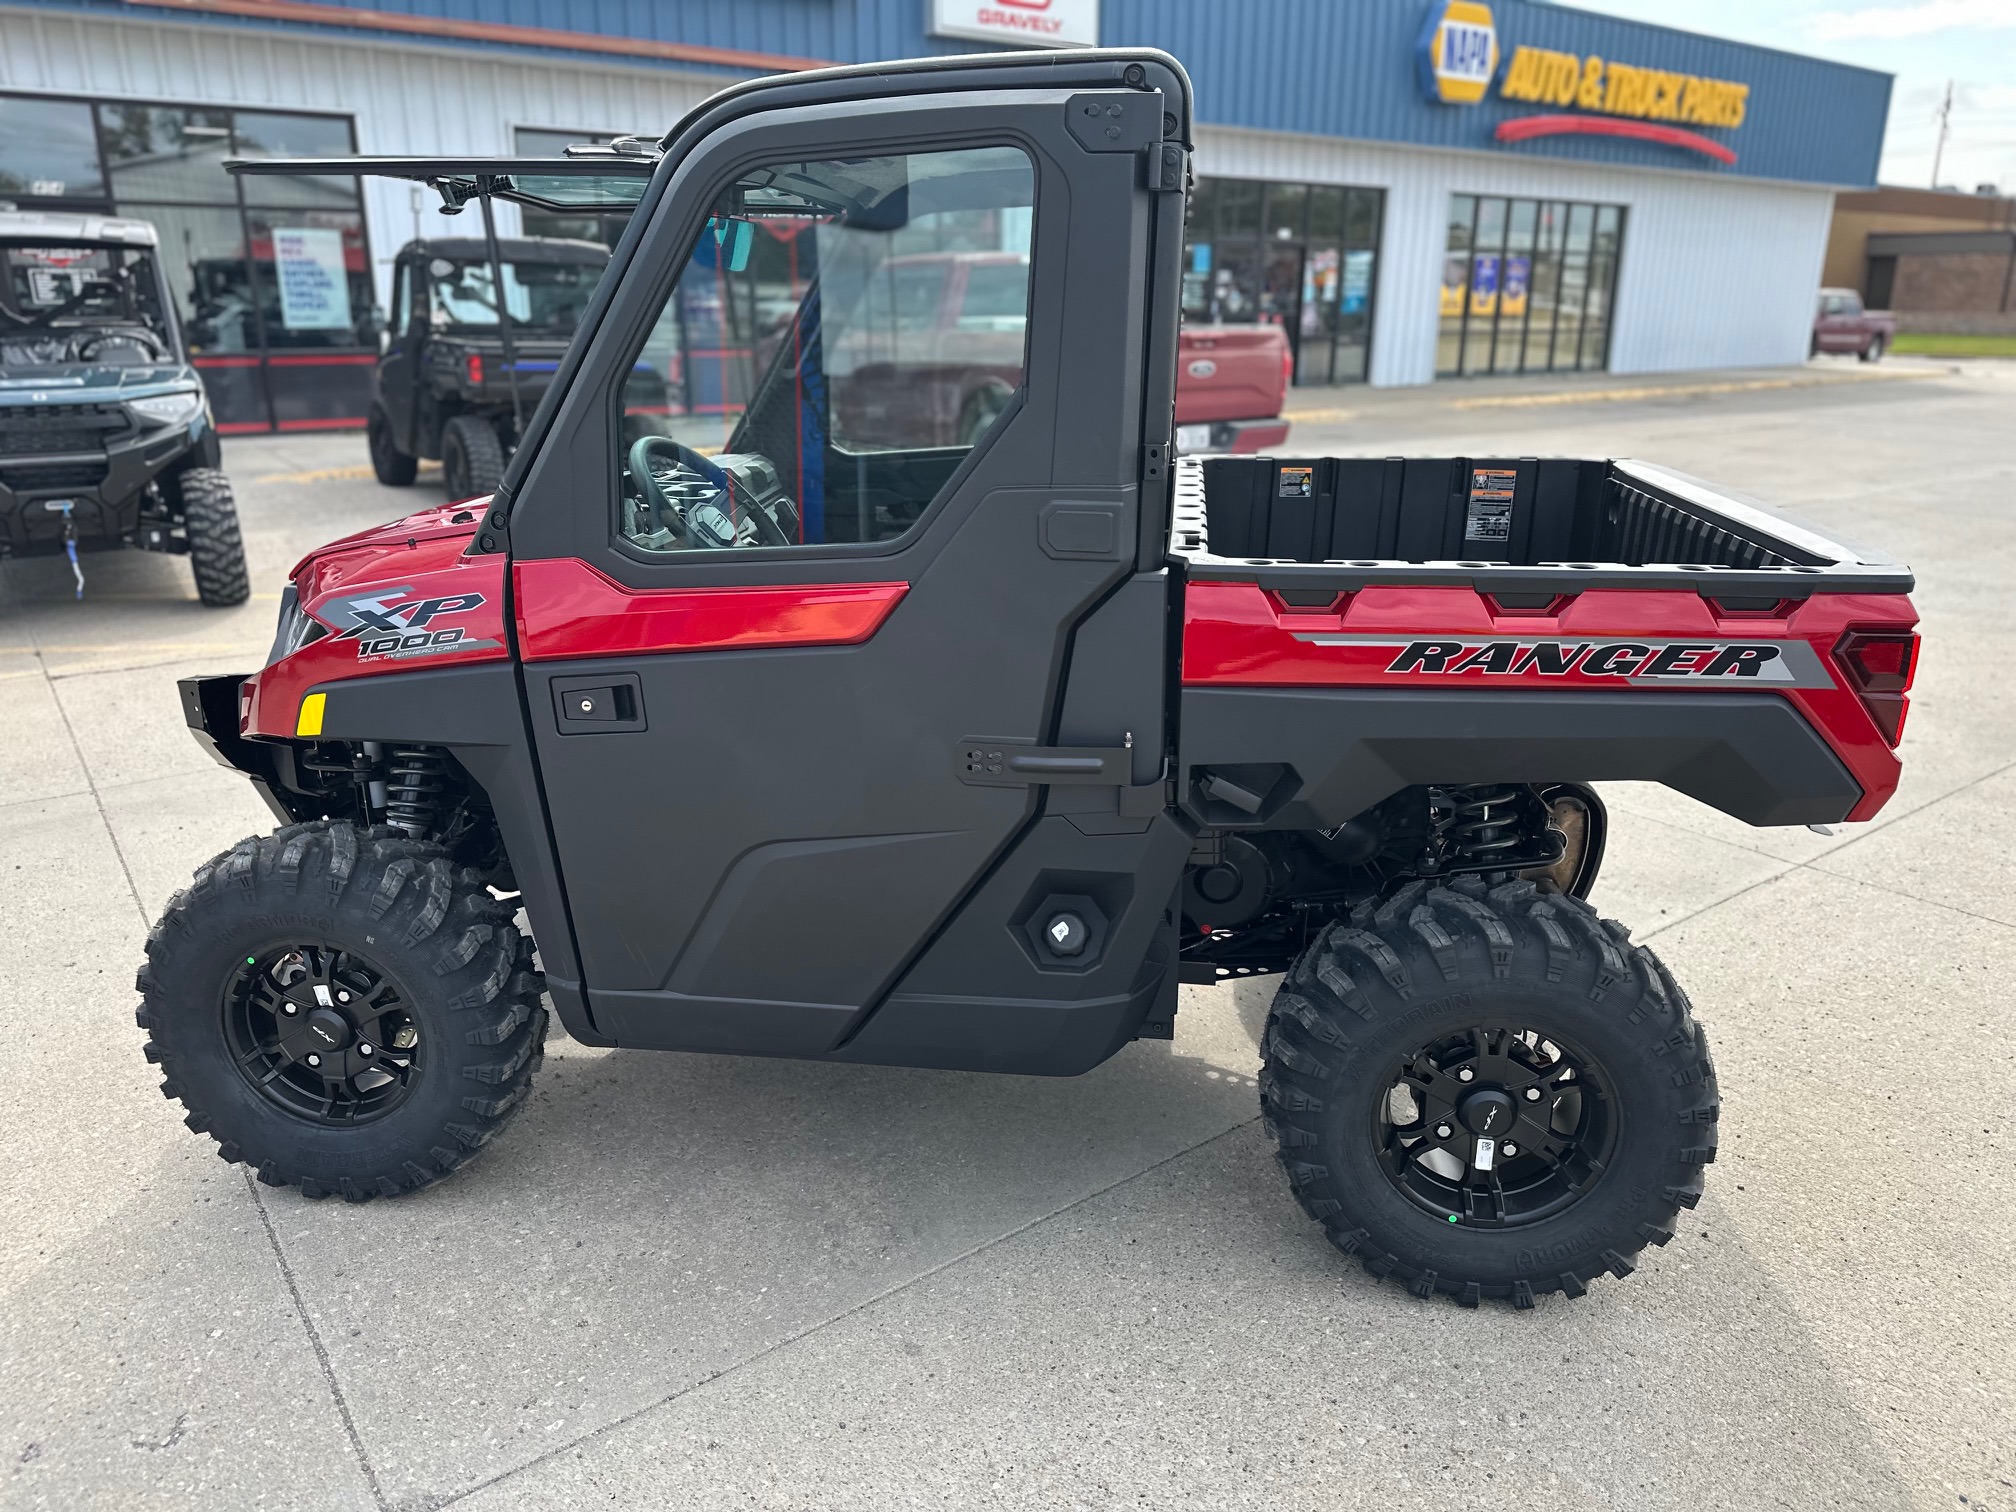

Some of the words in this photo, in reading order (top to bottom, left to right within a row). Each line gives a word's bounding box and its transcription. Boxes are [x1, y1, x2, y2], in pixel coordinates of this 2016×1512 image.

[978, 8, 1063, 33] GRAVELY
[1445, 24, 1491, 77] NAPA
[1501, 45, 1580, 106] AUTO
[1578, 55, 1604, 110] &
[1604, 61, 1688, 121] TRUCK
[1681, 75, 1750, 129] PARTS
[328, 592, 487, 643] XP
[357, 627, 466, 658] 1000
[358, 655, 382, 664] DUAL
[383, 648, 435, 660] OVERHEAD
[436, 644, 459, 653] CAM
[1384, 641, 1782, 678] RANGER
